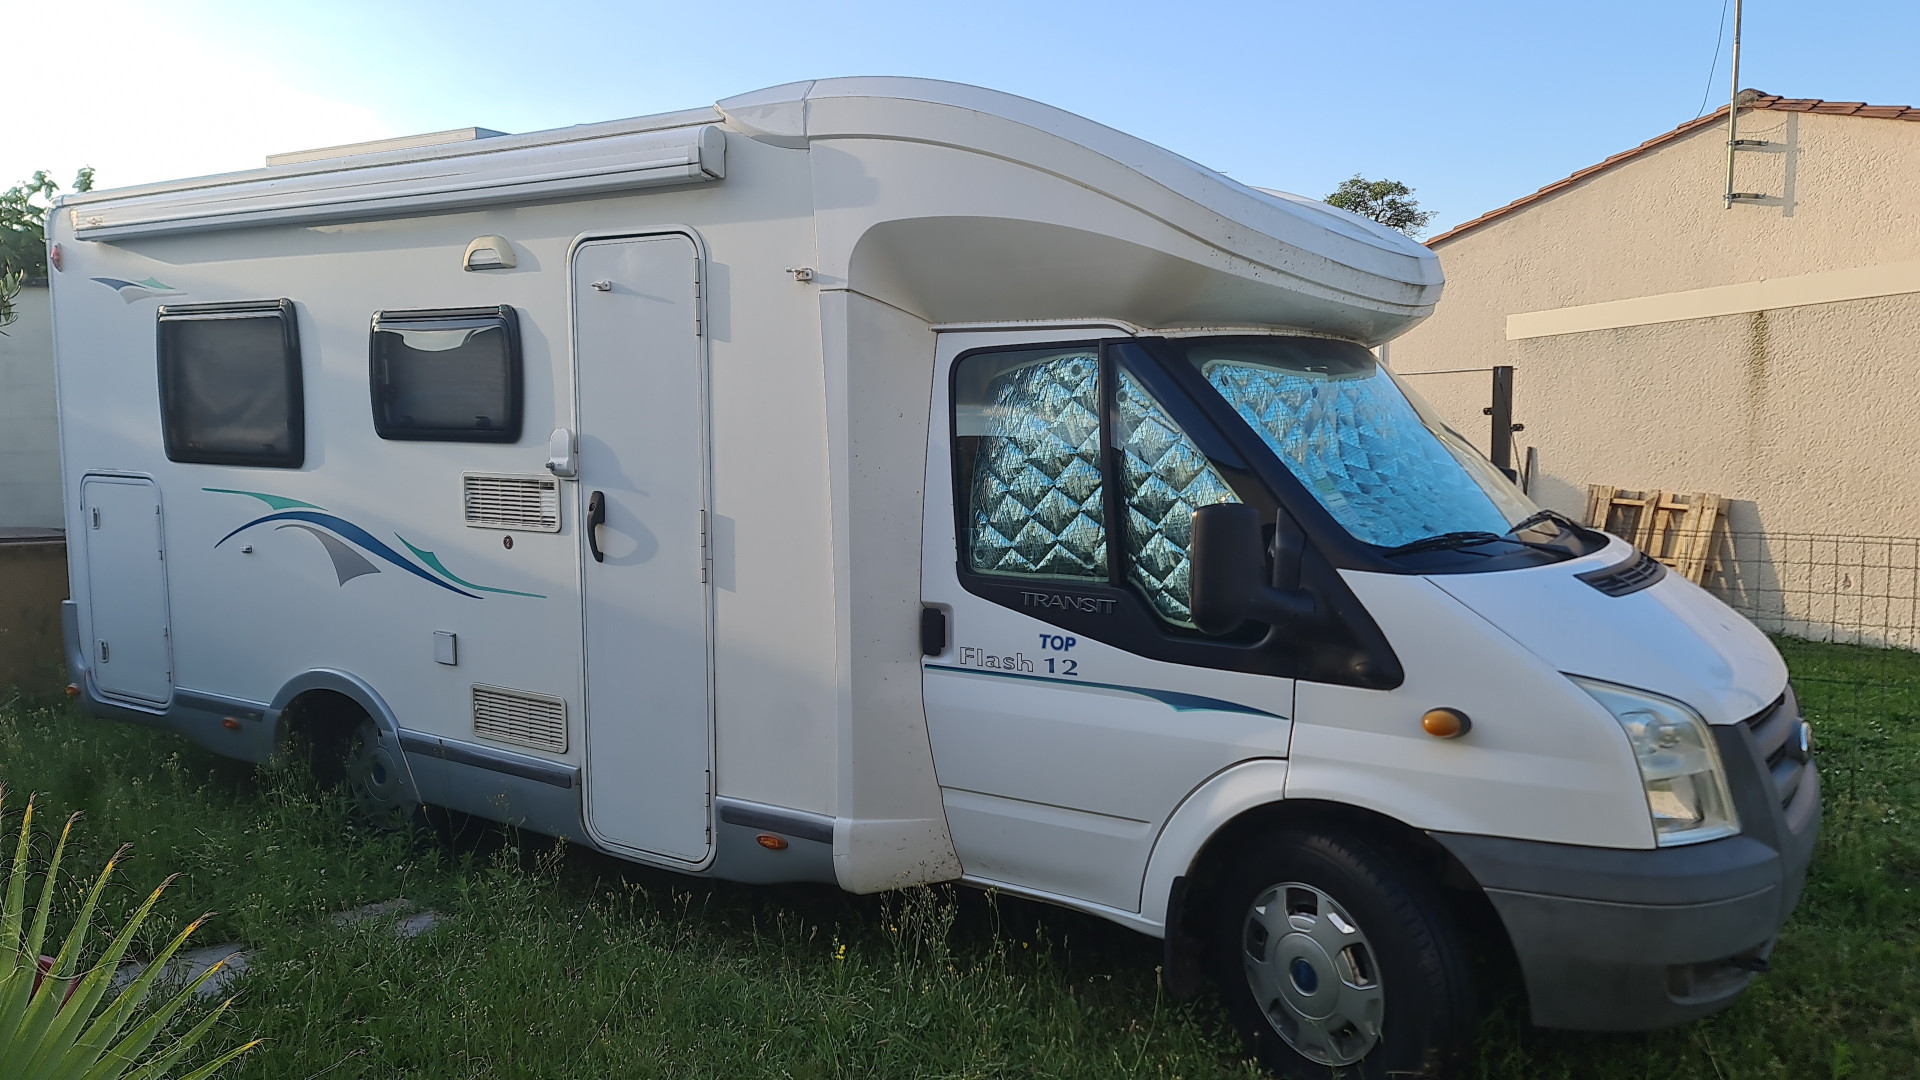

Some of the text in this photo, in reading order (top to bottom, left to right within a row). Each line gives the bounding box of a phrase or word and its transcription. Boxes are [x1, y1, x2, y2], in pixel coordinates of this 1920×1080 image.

[1020, 591, 1117, 614] TRANSIT
[1039, 633, 1077, 652] TOP
[959, 646, 1078, 676] Flash 12
